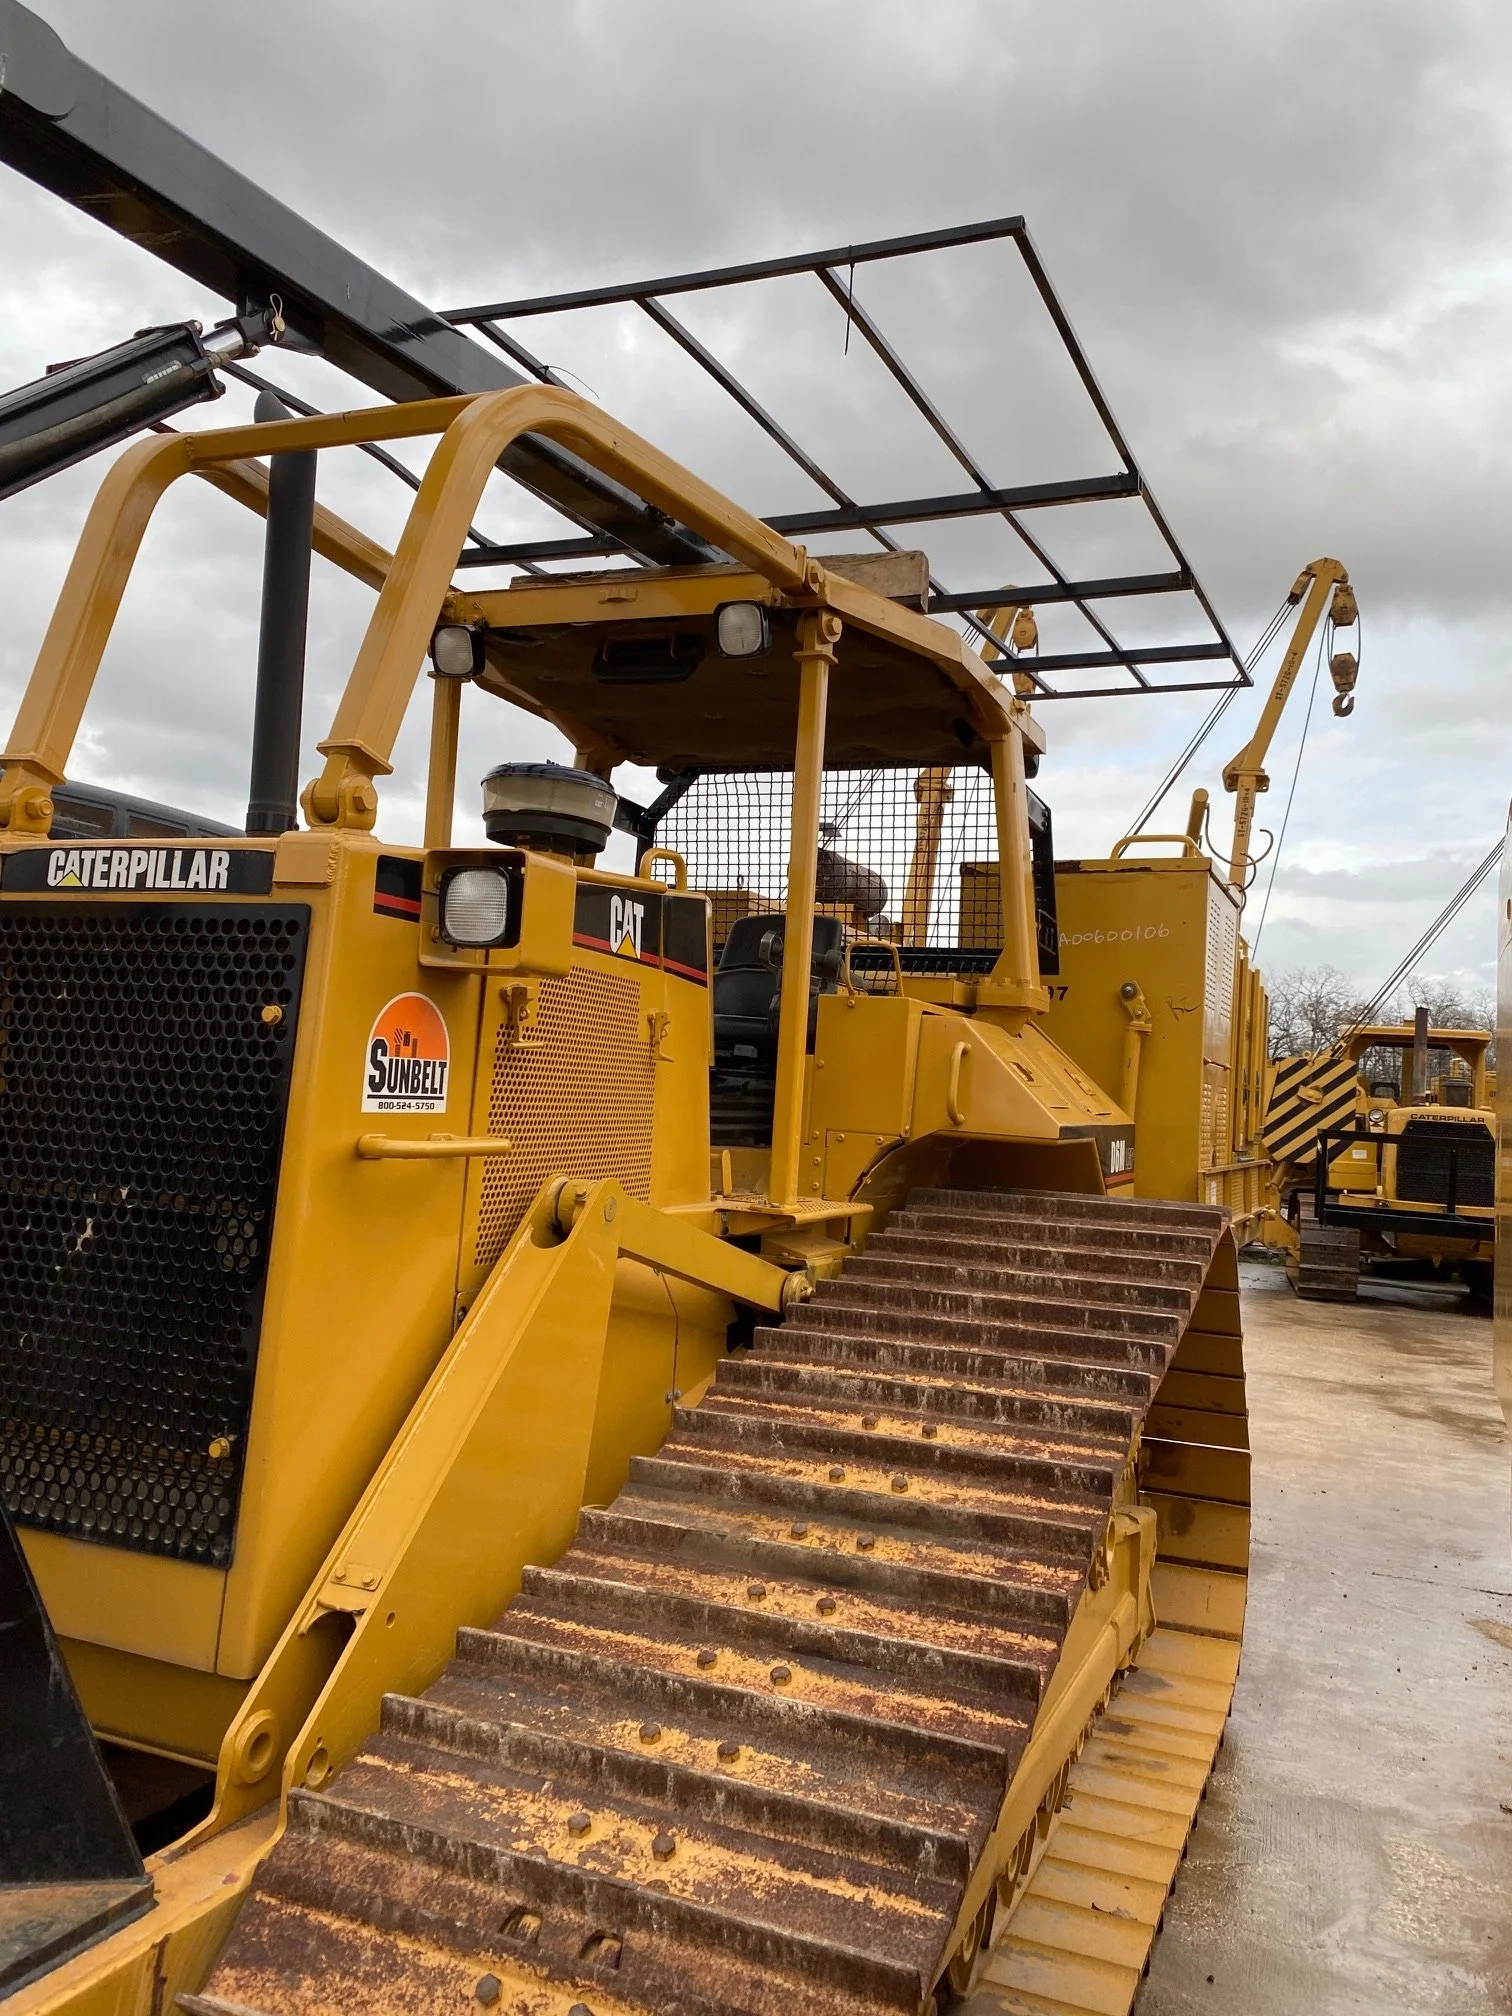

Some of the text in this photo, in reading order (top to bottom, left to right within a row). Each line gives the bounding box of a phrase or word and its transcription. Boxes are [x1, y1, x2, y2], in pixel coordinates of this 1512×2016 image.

[47, 850, 230, 889] CATERPILLAR
[610, 894, 645, 960] CAT
[1058, 922, 1170, 947] A00600106
[368, 1038, 447, 1095] SUNBELT
[378, 1101, 435, 1110] 800-524-5750
[1410, 1113, 1485, 1123] CATERPILLAR
